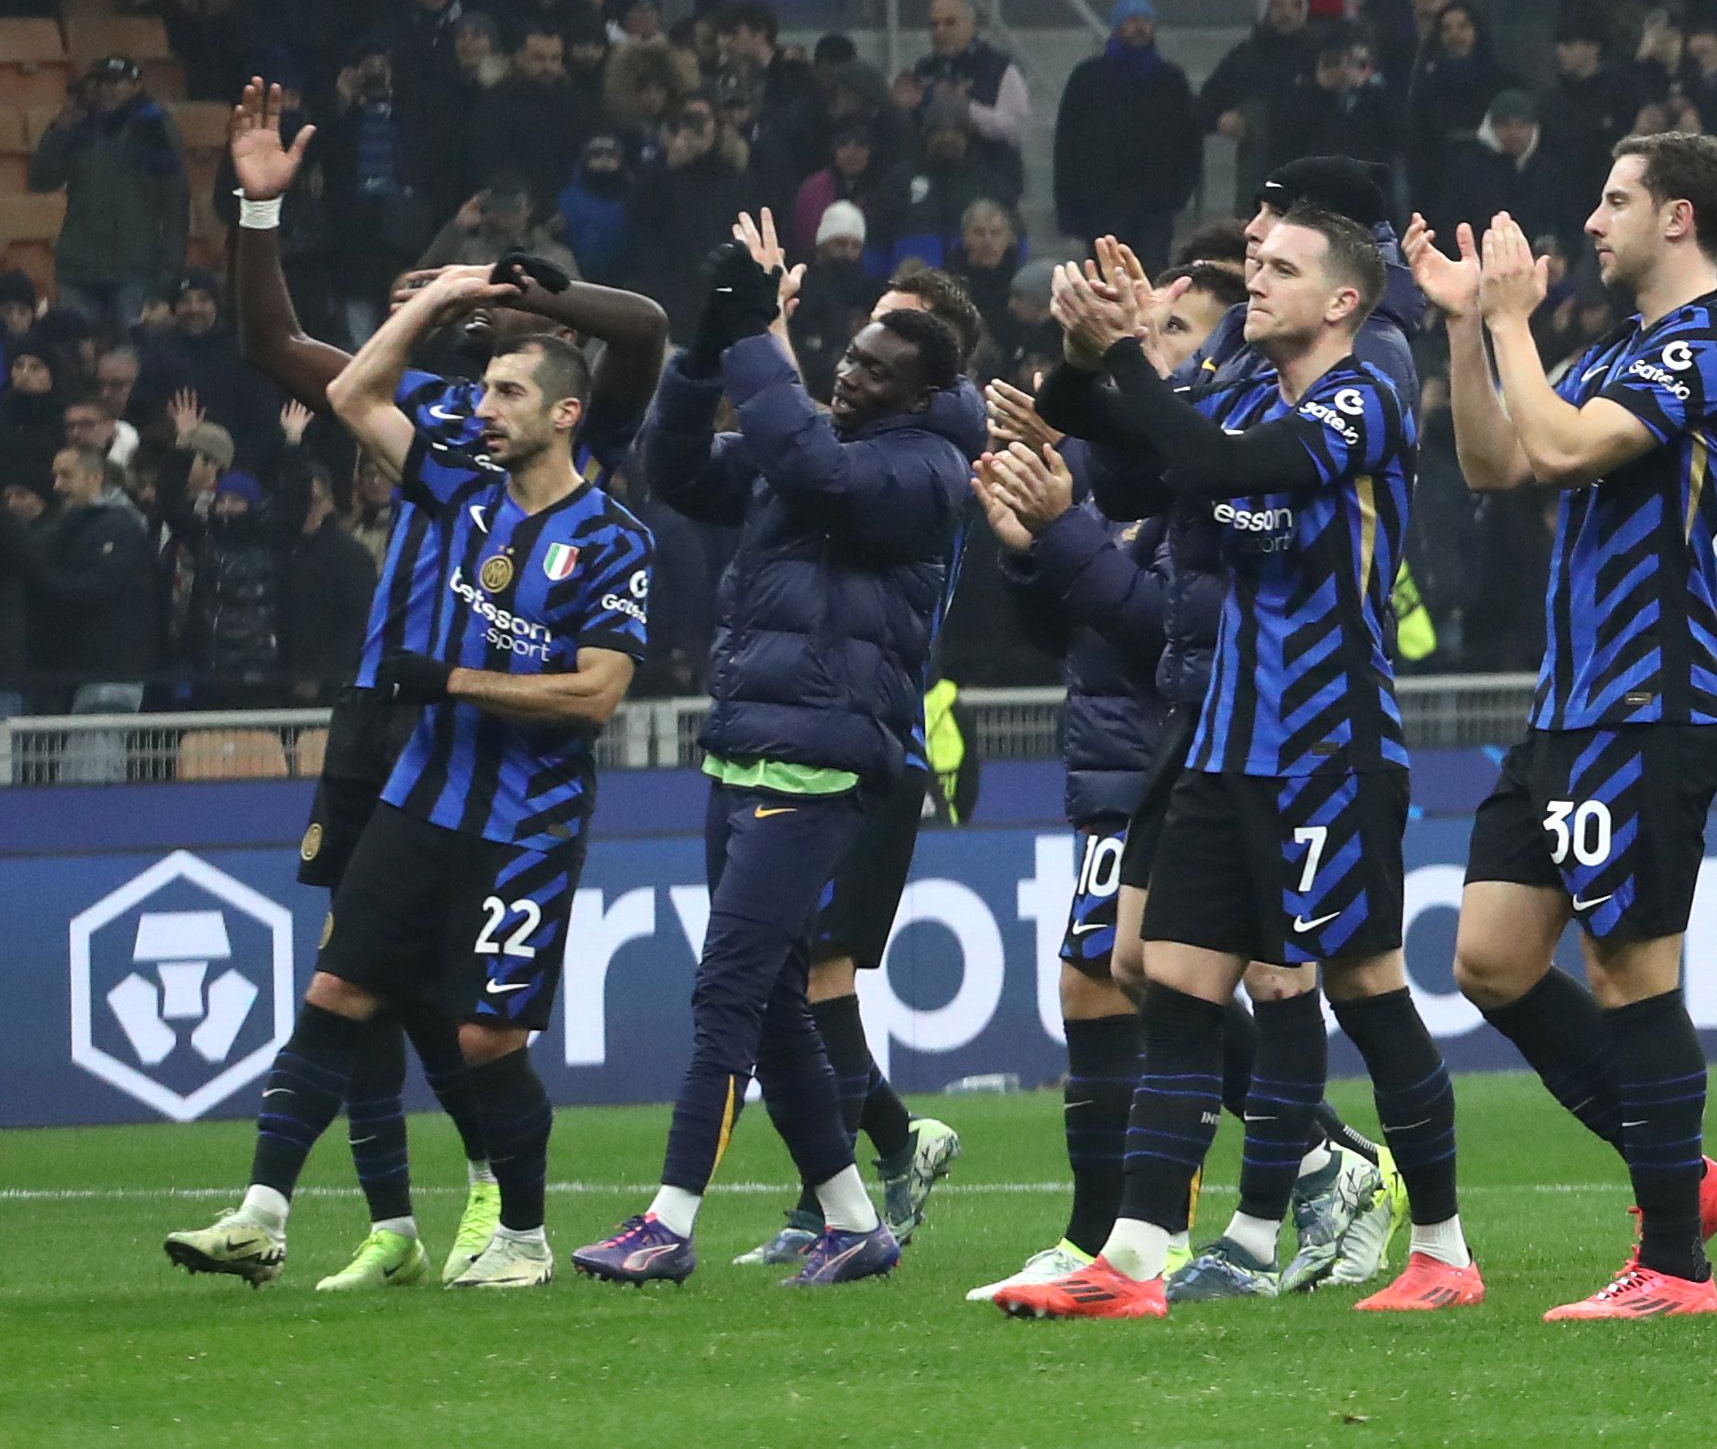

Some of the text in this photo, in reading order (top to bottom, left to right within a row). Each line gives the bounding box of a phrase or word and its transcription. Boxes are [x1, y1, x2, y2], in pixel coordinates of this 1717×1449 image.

[481, 626, 552, 663] .sport
[1293, 826, 1328, 892] 7
[1542, 800, 1612, 867] 30
[1078, 835, 1124, 897] 10
[473, 895, 542, 959] 22
